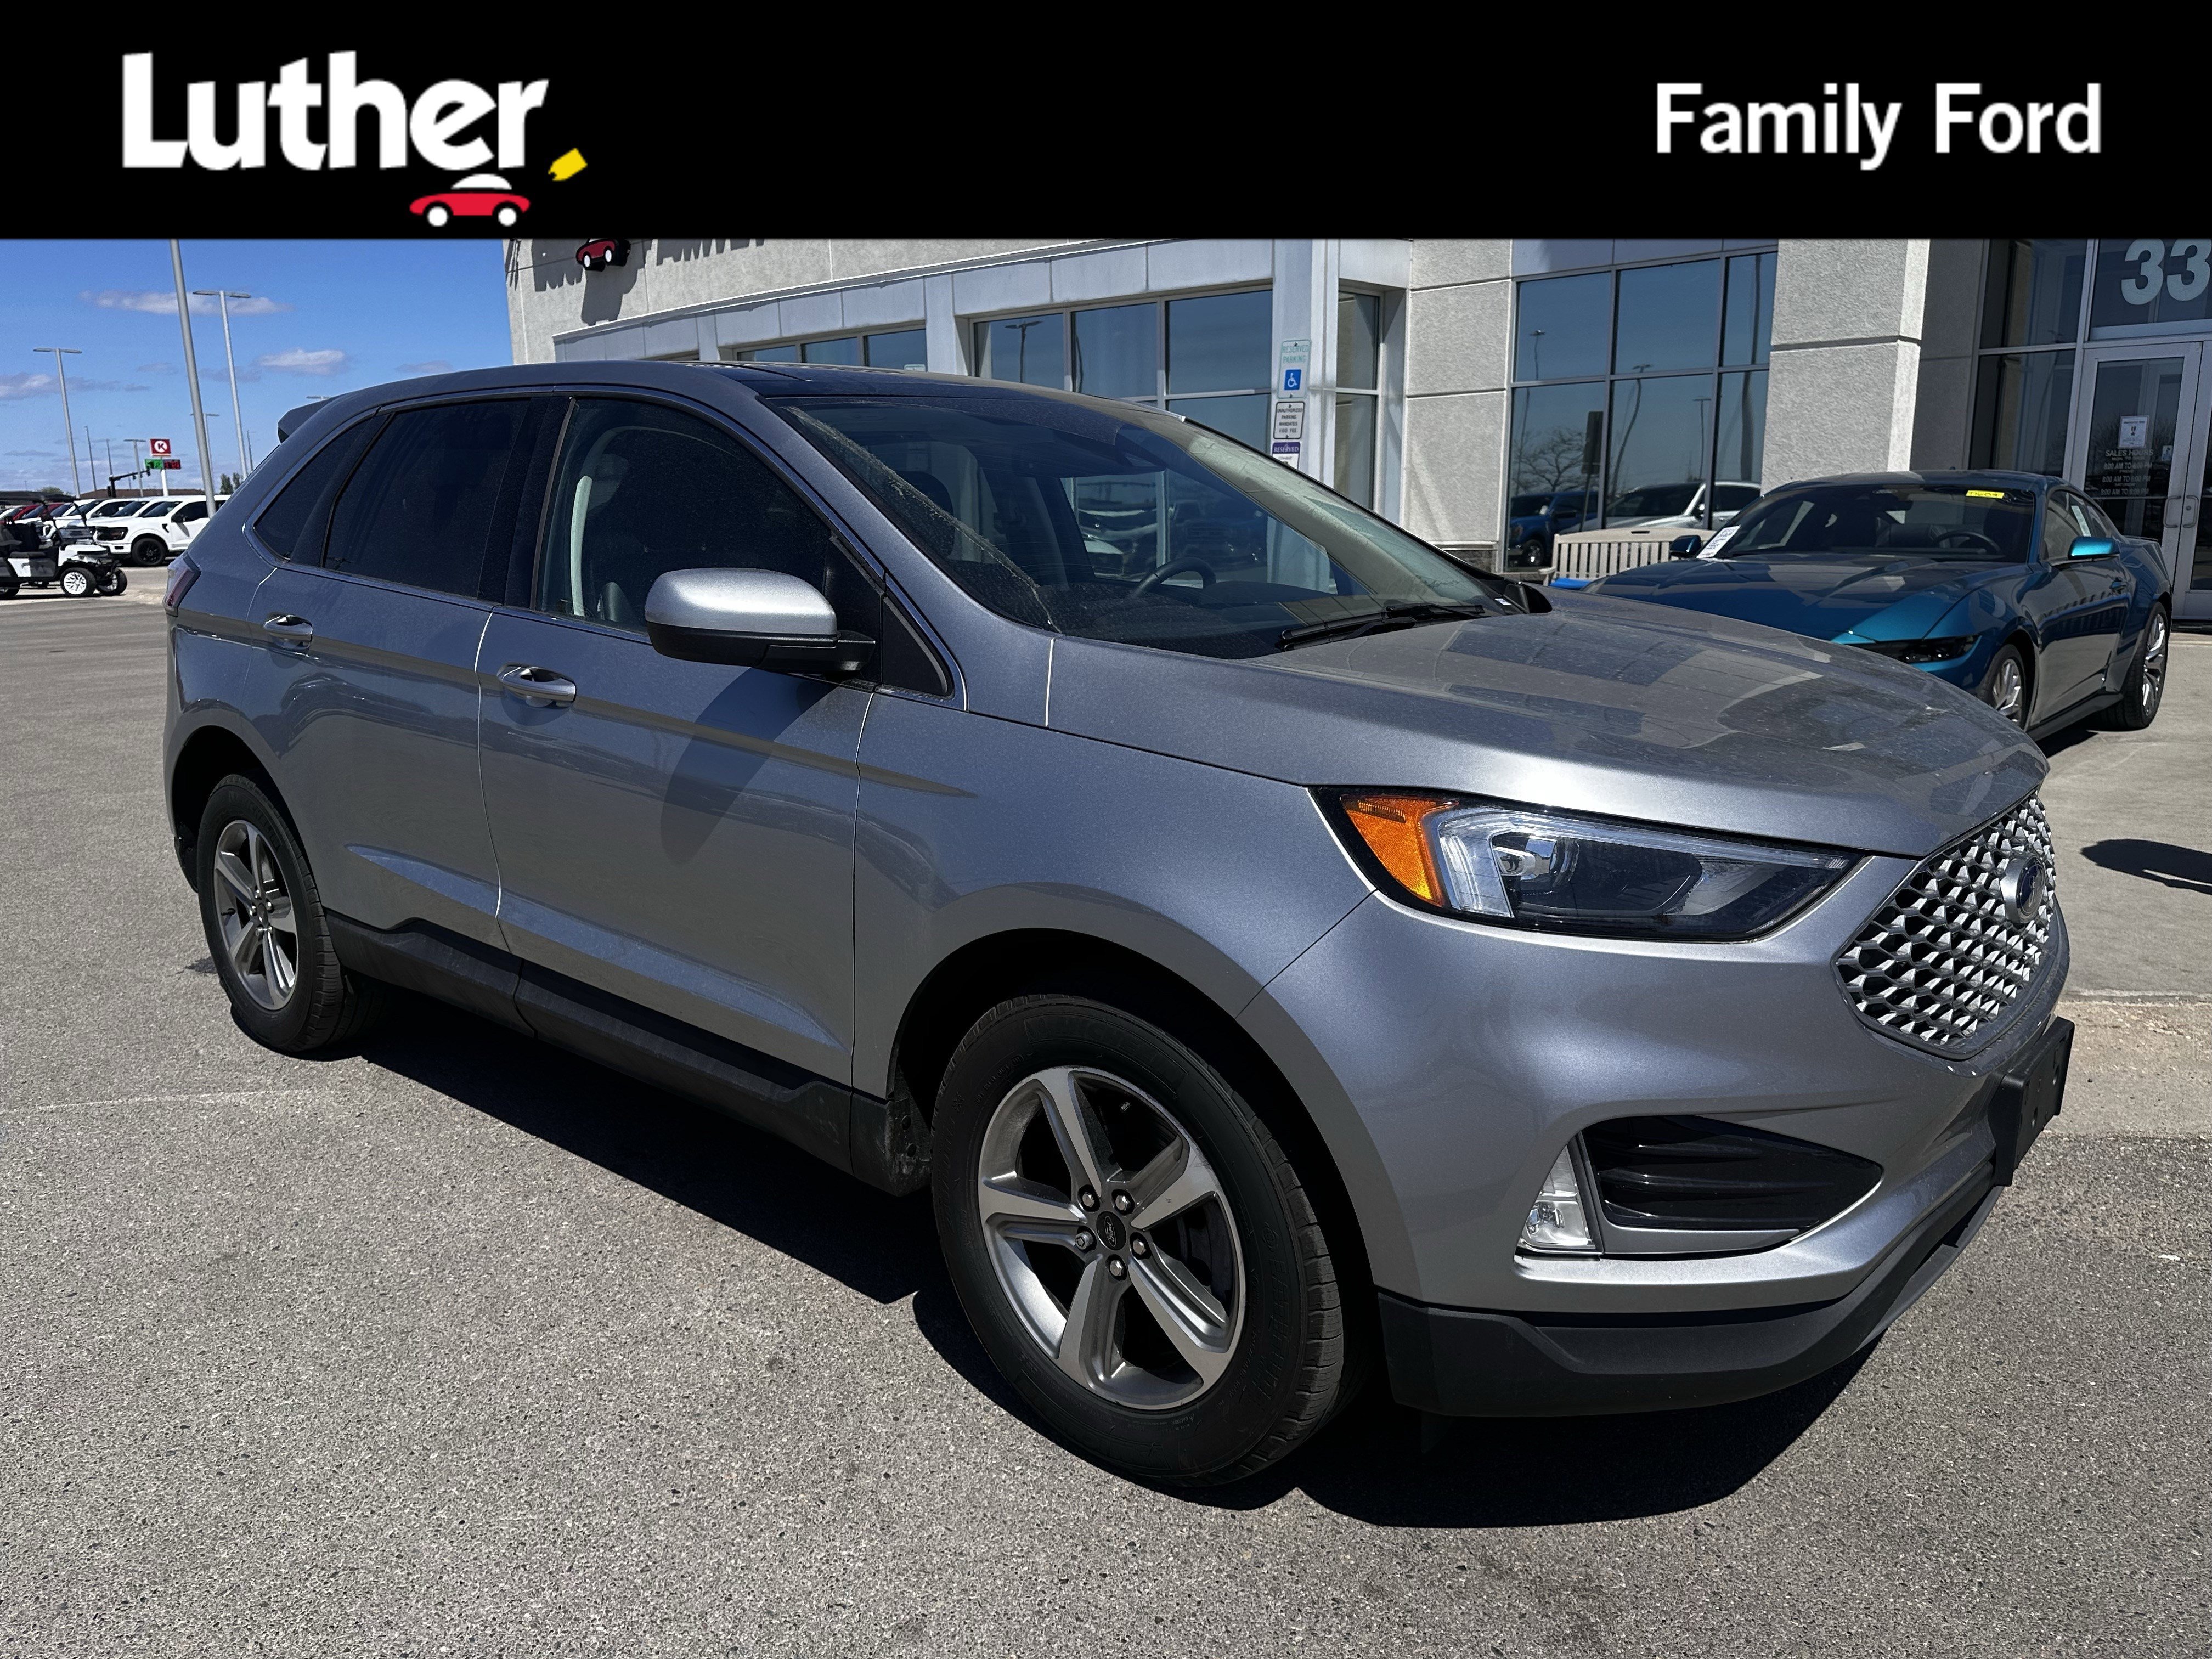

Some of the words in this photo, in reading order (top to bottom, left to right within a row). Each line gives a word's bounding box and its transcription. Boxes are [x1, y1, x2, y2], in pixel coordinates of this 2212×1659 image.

[1282, 345, 1310, 353] RESERVED
[1283, 355, 1307, 363] PARKING
[157, 443, 166, 451] K
